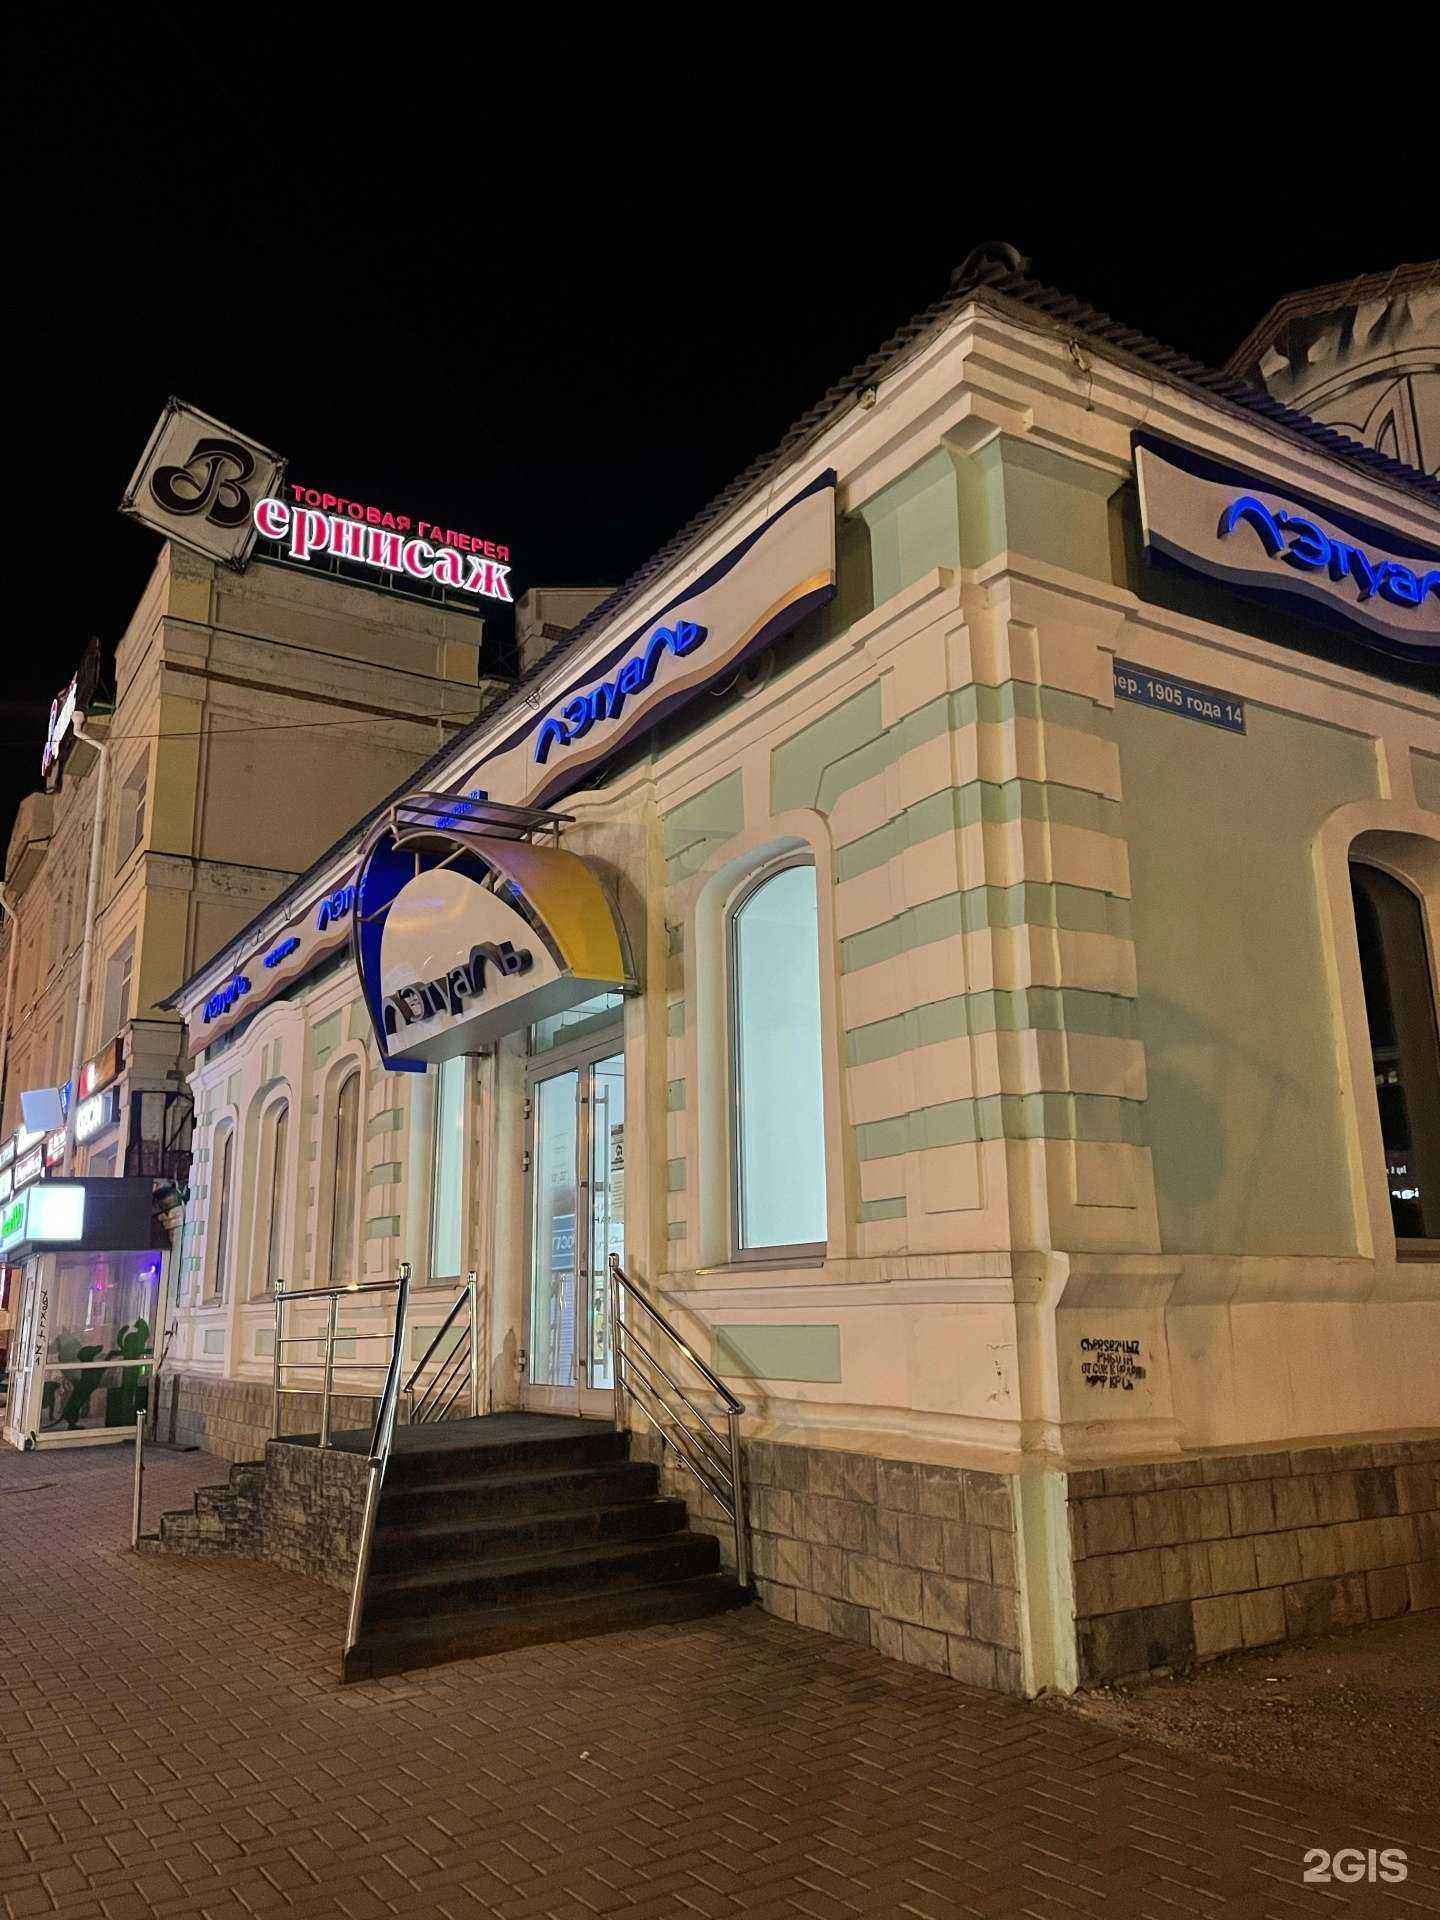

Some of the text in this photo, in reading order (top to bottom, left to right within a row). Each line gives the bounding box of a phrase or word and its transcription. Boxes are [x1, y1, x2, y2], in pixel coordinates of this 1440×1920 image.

[291, 484, 510, 561] ТОРГОВАЯ ГАЛЕРЕЯ
[1147, 681, 1183, 706] 1905
[1187, 697, 1221, 718] года
[1226, 706, 1242, 723] 14
